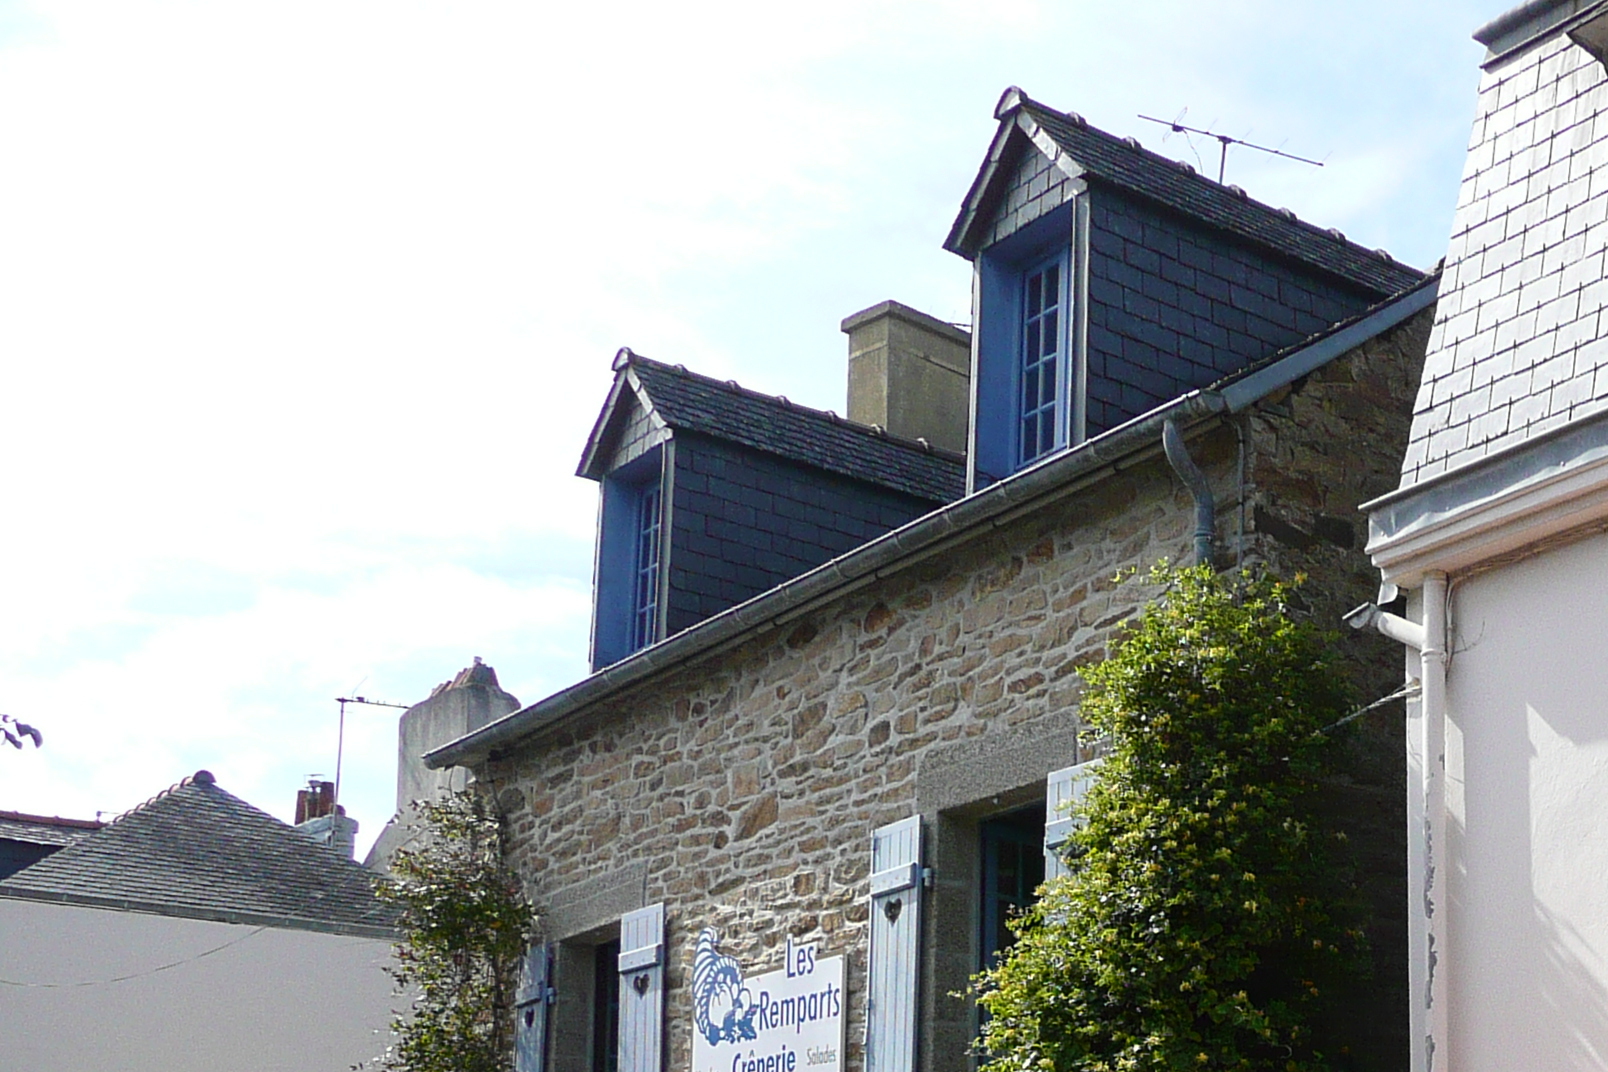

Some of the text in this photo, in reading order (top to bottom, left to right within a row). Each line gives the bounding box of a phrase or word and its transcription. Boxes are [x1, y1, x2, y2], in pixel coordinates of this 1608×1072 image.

[786, 939, 815, 979] Les
[758, 983, 841, 1034] Remparts
[806, 1044, 837, 1066] Salades
